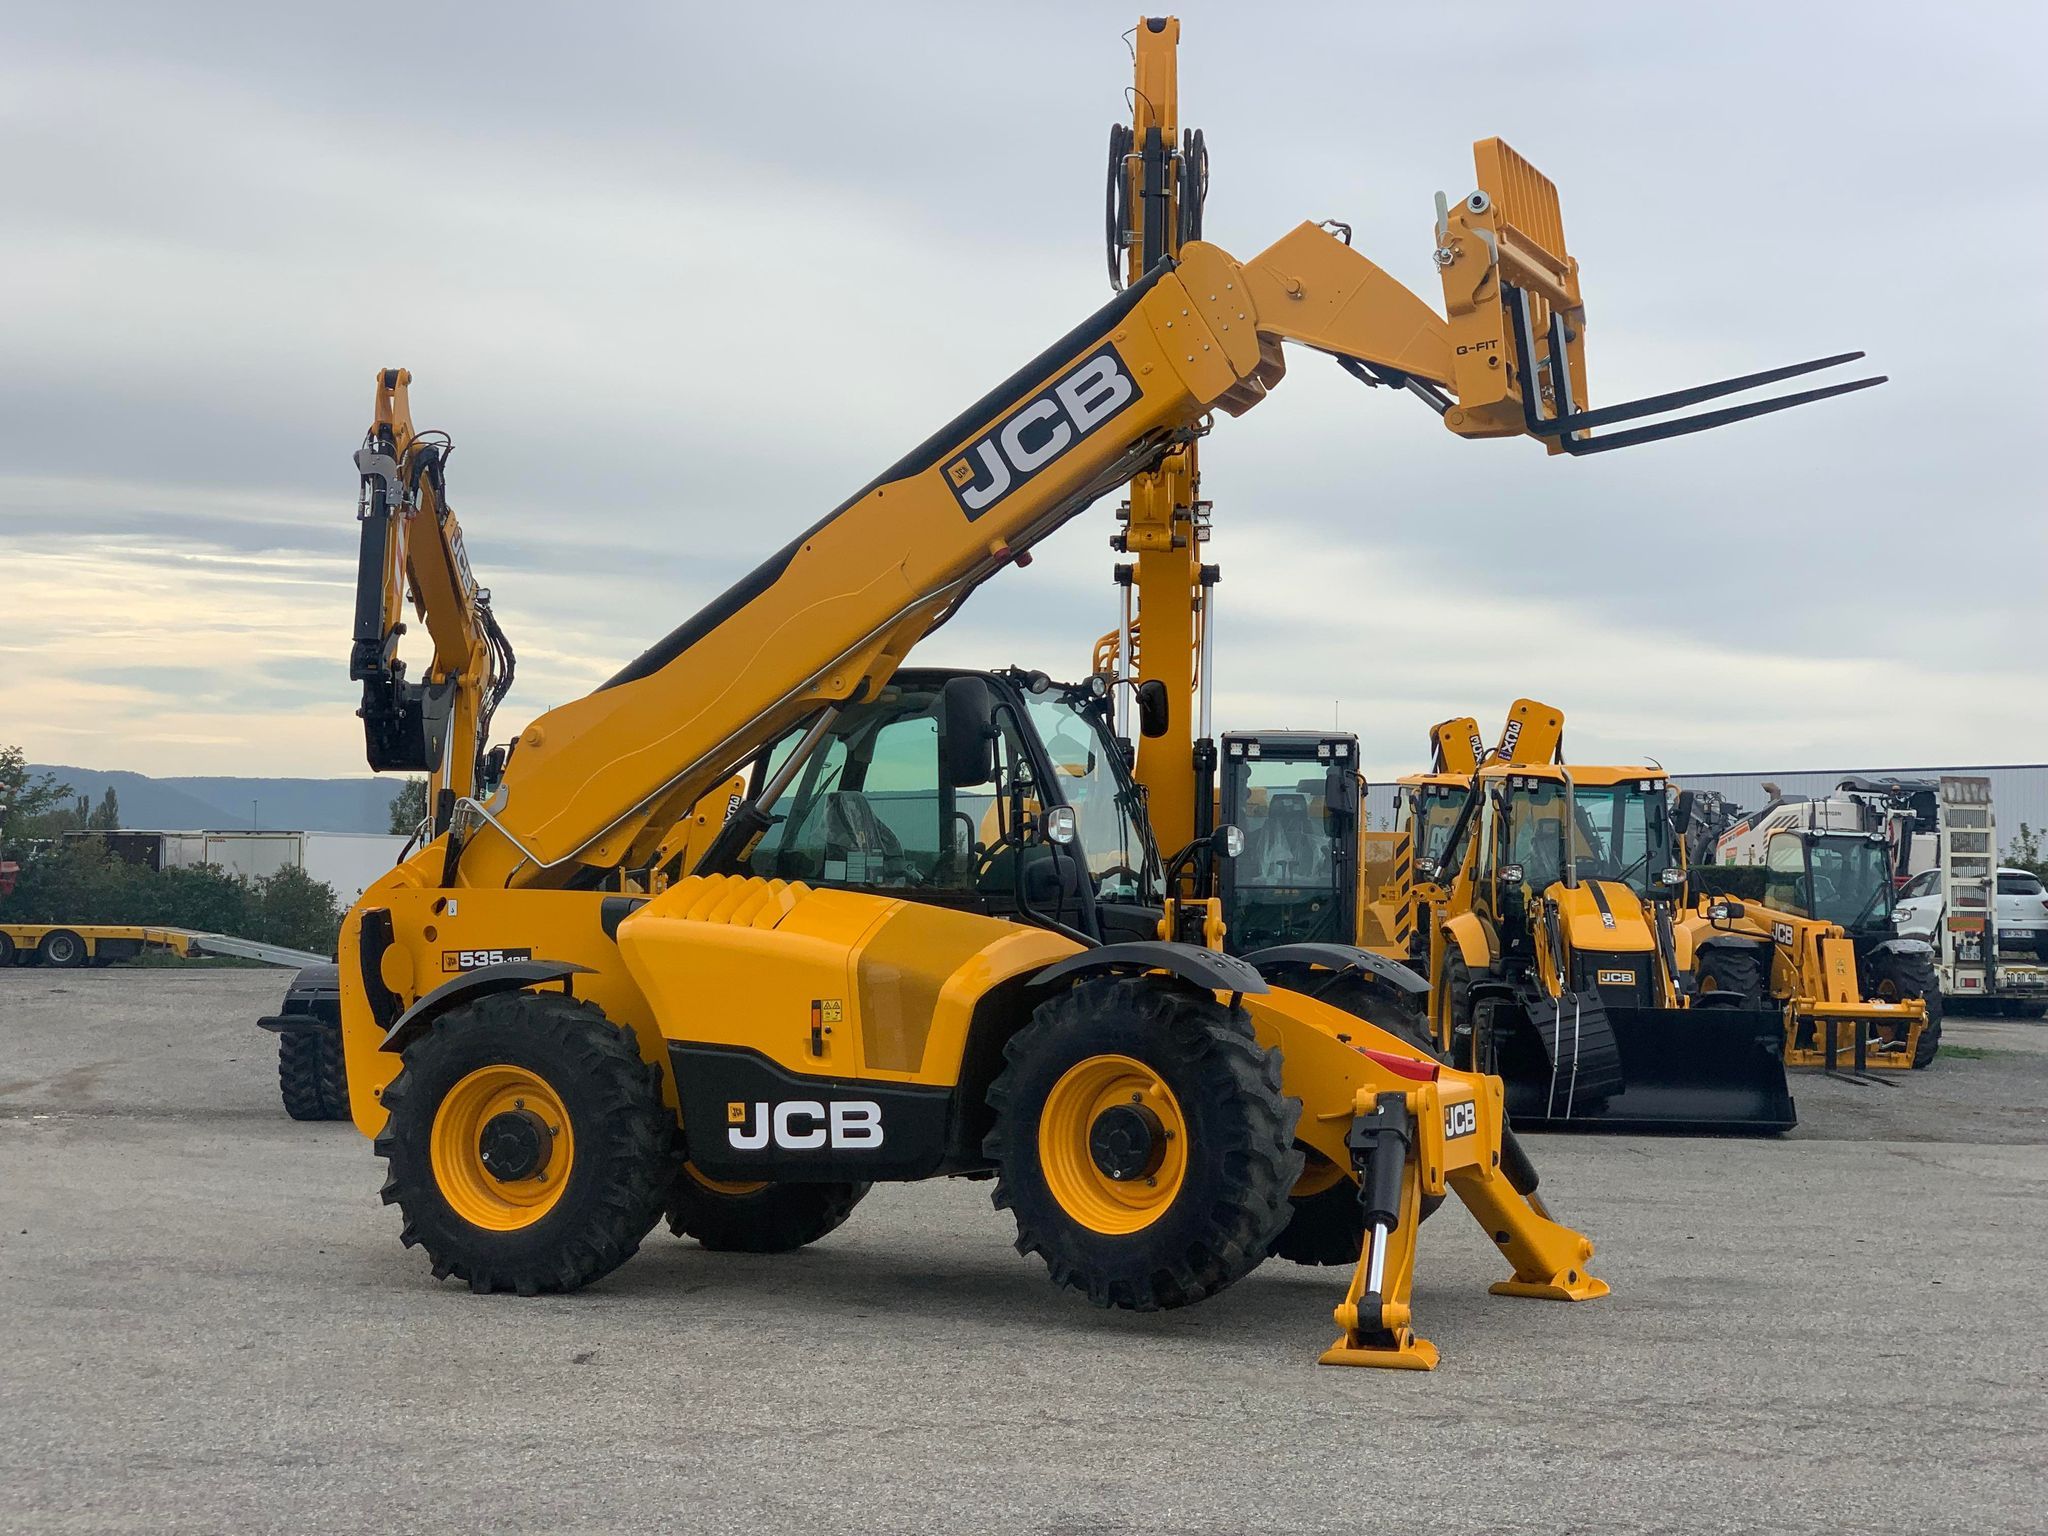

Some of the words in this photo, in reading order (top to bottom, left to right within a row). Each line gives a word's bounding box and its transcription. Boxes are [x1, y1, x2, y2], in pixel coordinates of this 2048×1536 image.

[1456, 339, 1498, 355] Q-FIT
[961, 354, 1132, 510] JCB
[451, 534, 472, 597] JCB
[1501, 721, 1522, 753] 3CX
[1771, 921, 1793, 945] JCB
[1601, 972, 1633, 982] JCB
[728, 1100, 884, 1149] JCB
[1445, 1102, 1476, 1137] JCB
